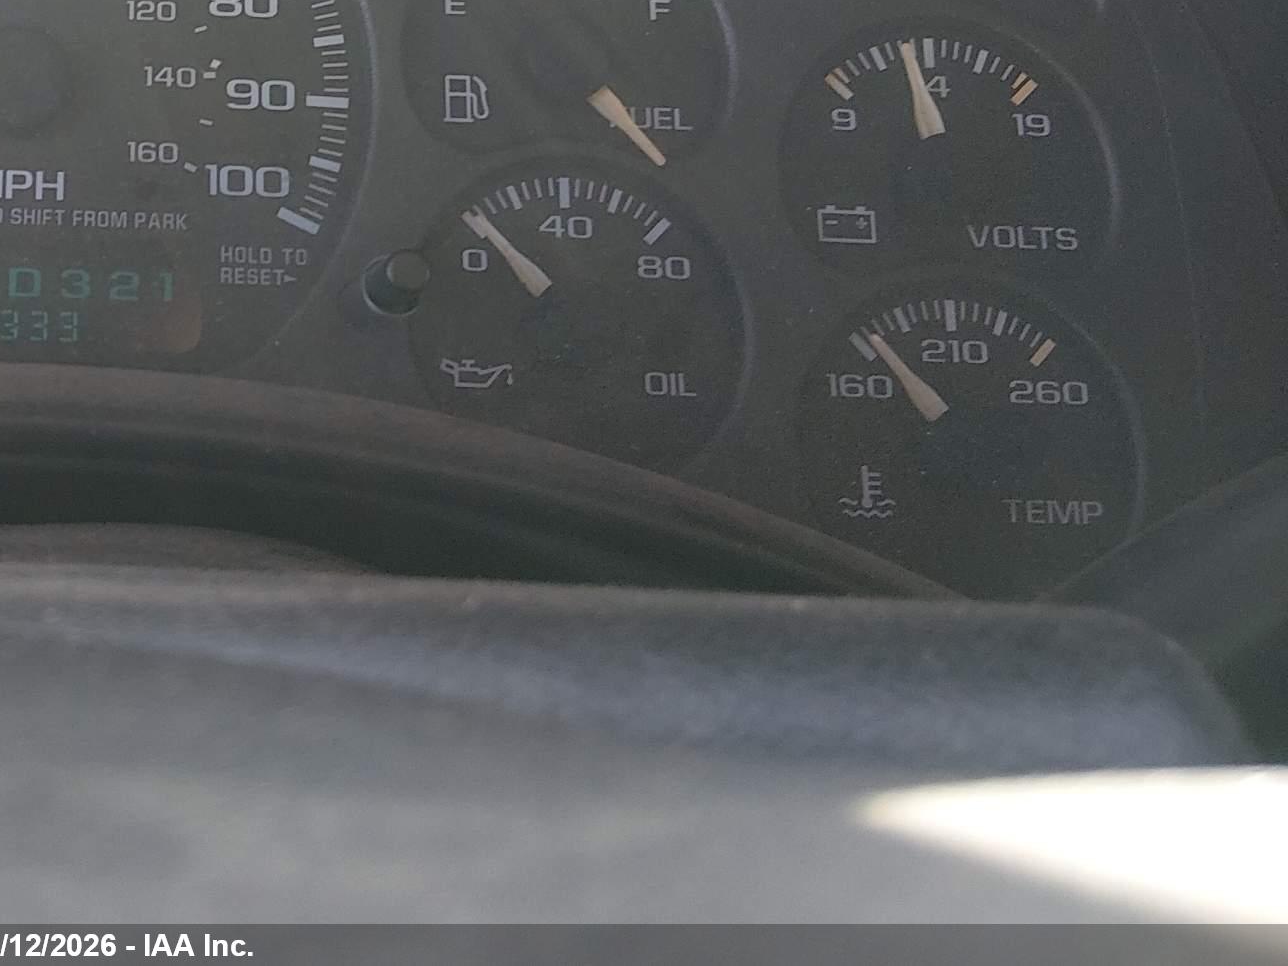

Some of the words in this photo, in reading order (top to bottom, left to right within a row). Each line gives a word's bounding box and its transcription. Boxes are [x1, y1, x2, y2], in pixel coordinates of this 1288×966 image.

[126, 0, 177, 21] 120
[649, 0, 672, 20] F
[144, 66, 197, 87] 140
[225, 79, 295, 110] 90
[610, 107, 694, 130] UEL
[831, 109, 857, 131] 9
[1012, 114, 1051, 136] 19
[127, 142, 179, 164] 160
[207, 164, 289, 197] 100
[11, 208, 65, 226] SHIFT
[72, 209, 127, 229] FROM
[134, 211, 188, 230] PARK
[539, 217, 592, 238] 40
[967, 224, 1079, 251] VOLTS
[220, 245, 272, 265] HOLD
[283, 247, 307, 266] TO
[462, 250, 487, 272] 0
[220, 267, 285, 286] RESET
[637, 256, 691, 280] 80
[8, 268, 42, 298] D
[60, 269, 90, 299] 3
[109, 271, 139, 301] 2
[153, 272, 173, 302] 1
[921, 340, 989, 364] 210
[645, 373, 696, 397] OIL
[827, 374, 894, 399] 160
[1009, 380, 1089, 406] 260
[1003, 499, 1104, 526] TEMP
